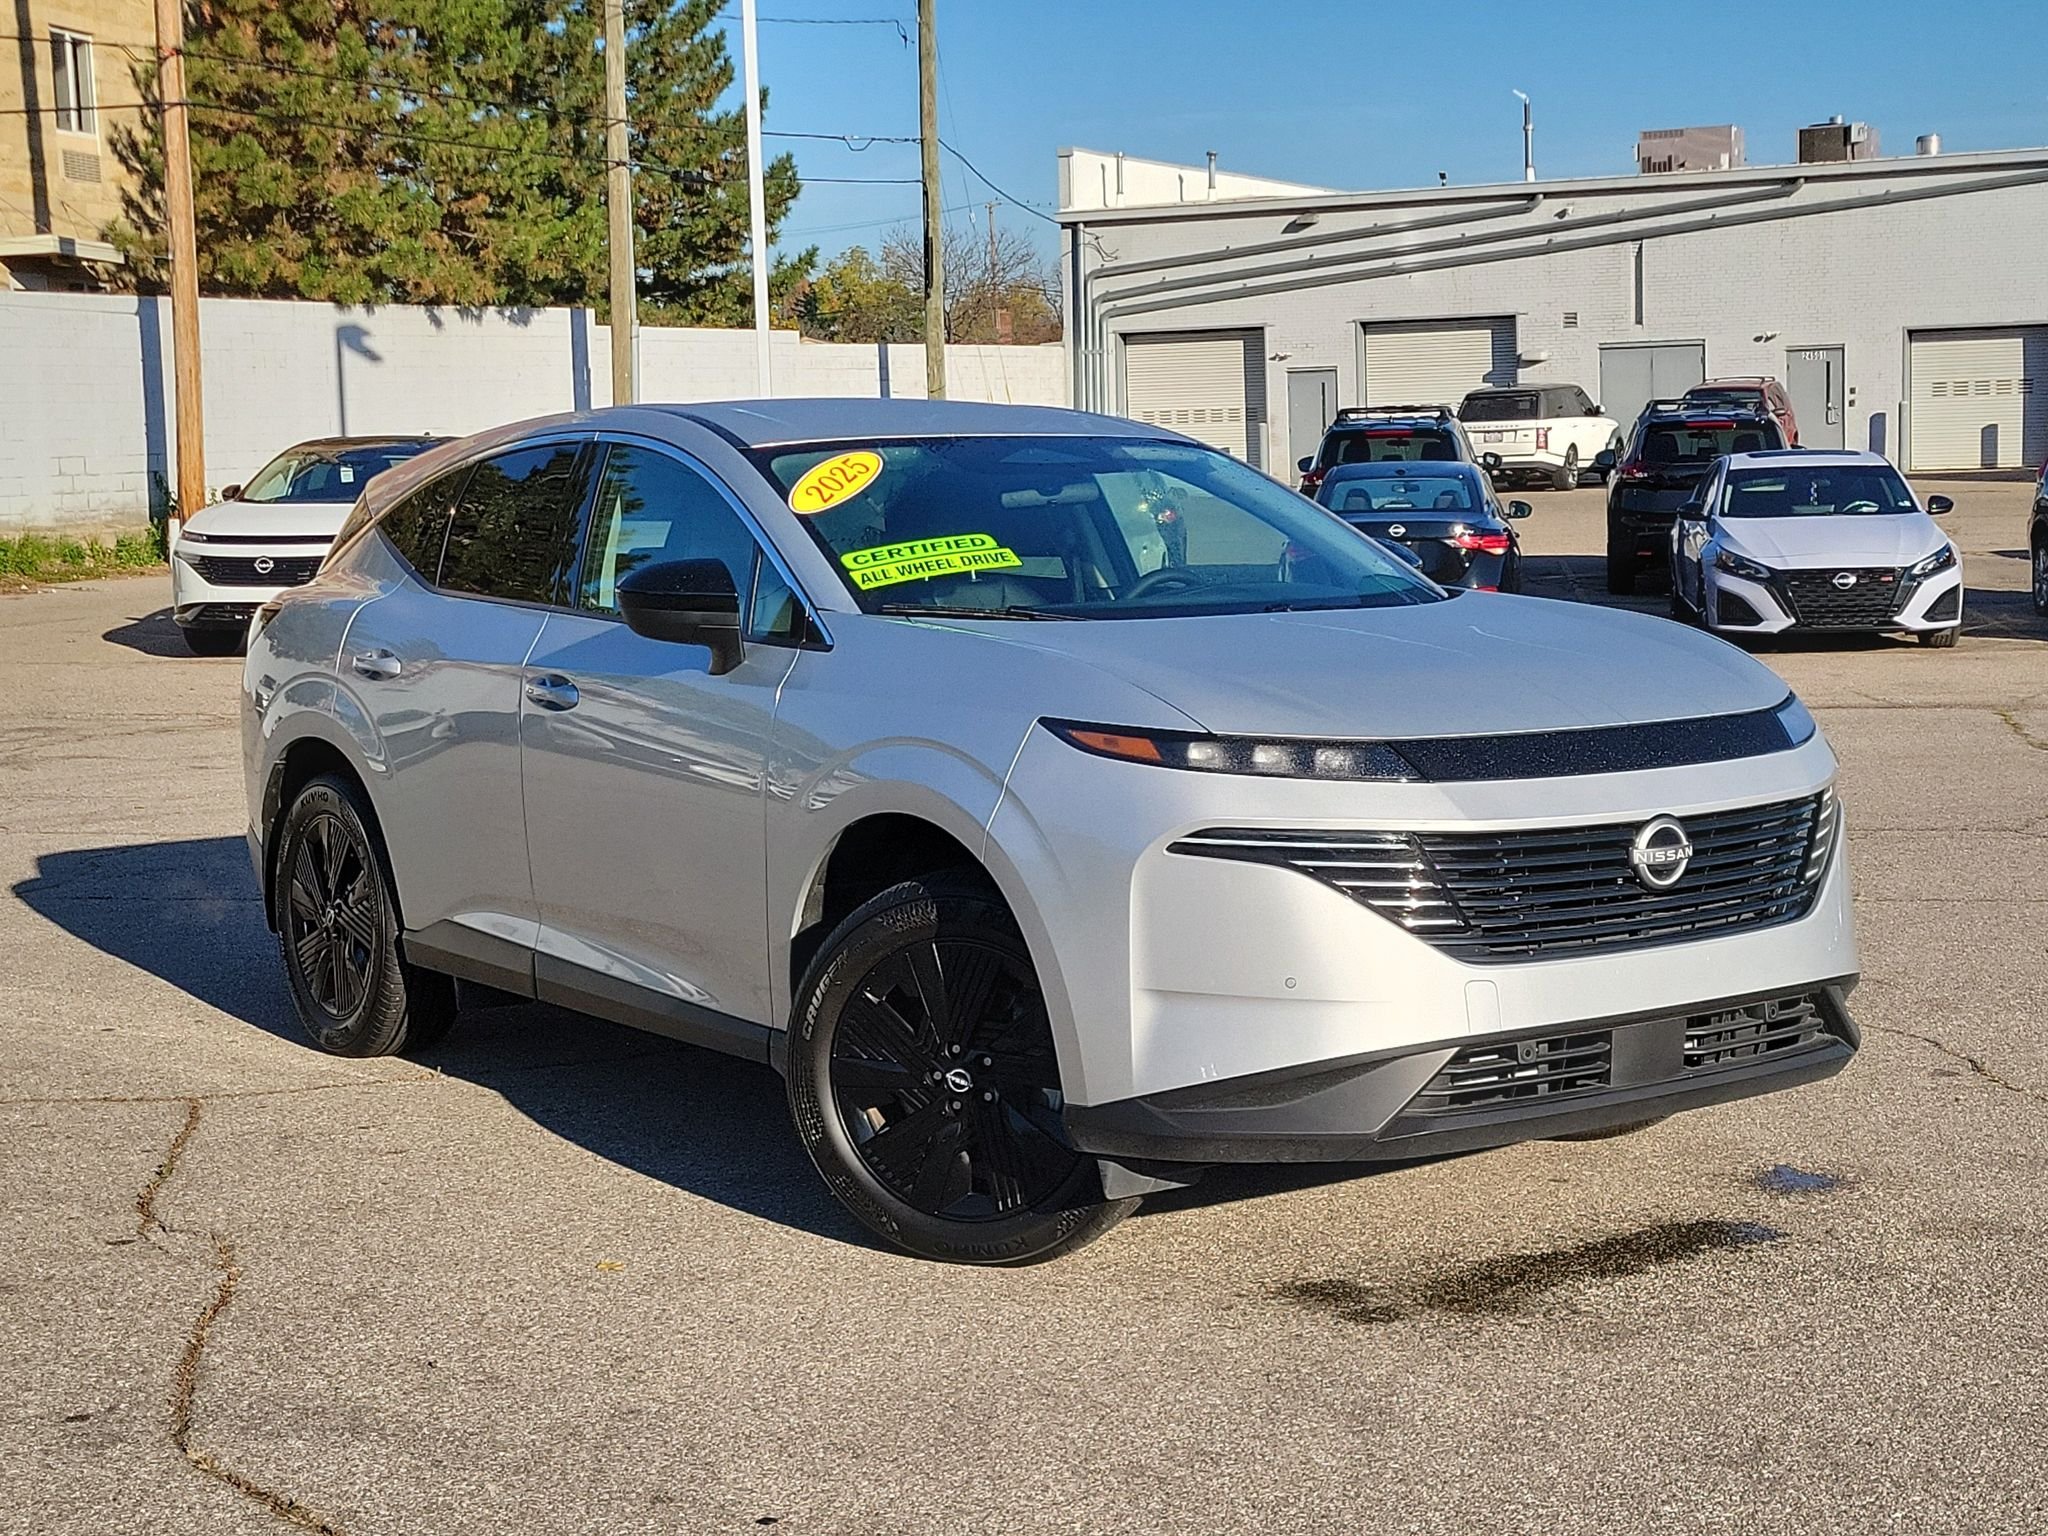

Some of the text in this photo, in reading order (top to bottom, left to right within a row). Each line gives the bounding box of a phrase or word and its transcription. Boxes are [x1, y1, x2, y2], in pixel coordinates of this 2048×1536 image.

[806, 457, 870, 503] 2025
[853, 537, 986, 565] CERTIFIED
[861, 551, 1010, 585] ALL WHEEL DRIVE
[301, 791, 329, 808] KUMHO
[1634, 845, 1693, 864] NISSAN
